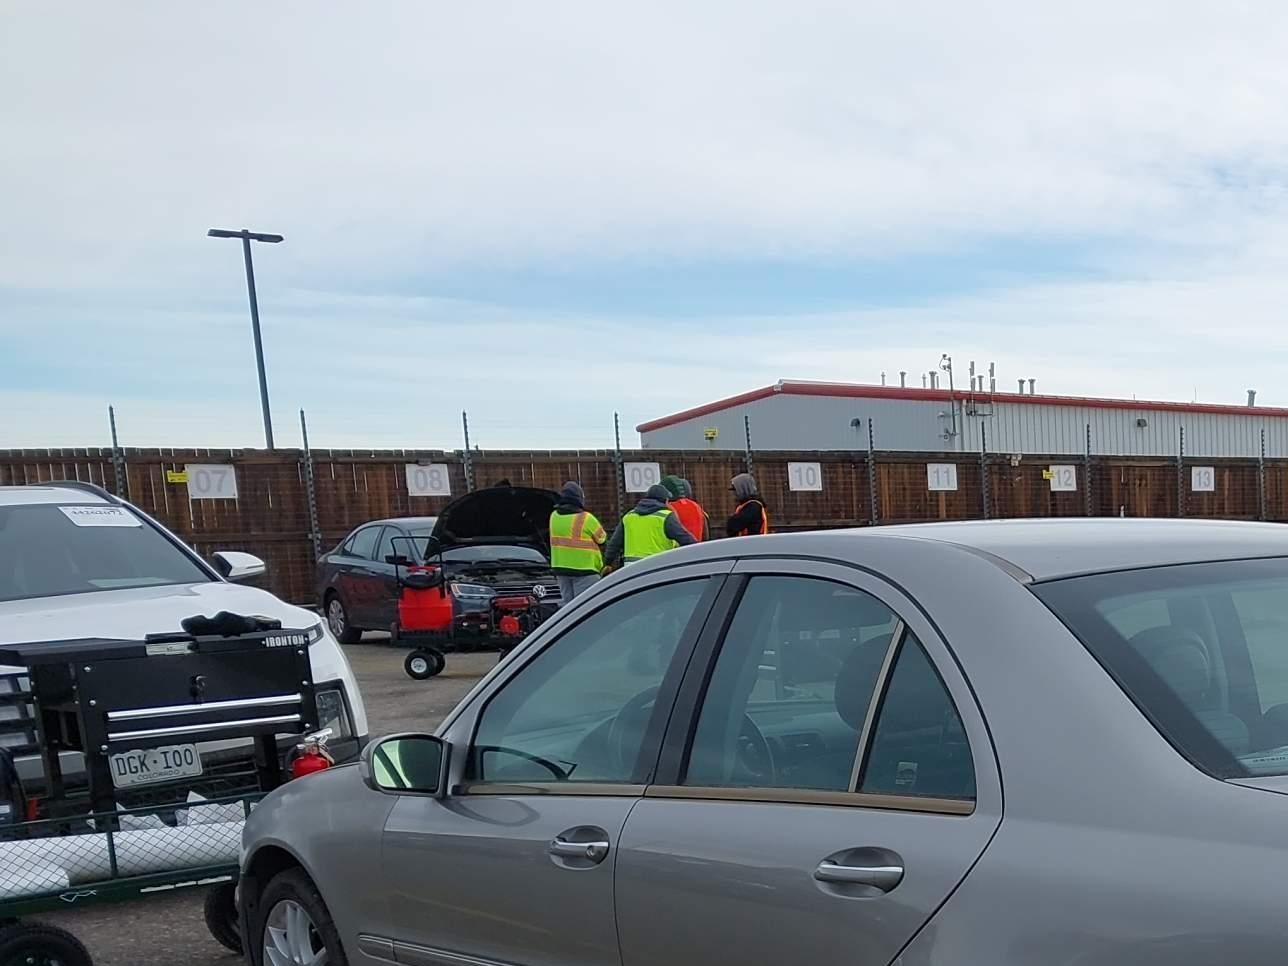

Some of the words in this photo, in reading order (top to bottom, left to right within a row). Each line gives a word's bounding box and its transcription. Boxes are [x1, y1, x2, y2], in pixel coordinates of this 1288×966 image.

[195, 469, 227, 493] 07
[414, 469, 443, 491] 08
[631, 467, 656, 488] 09
[795, 466, 817, 487] 10
[933, 467, 955, 487] 11
[1056, 469, 1073, 487] 12
[1196, 471, 1210, 487] 13
[265, 635, 304, 647] IRONTON
